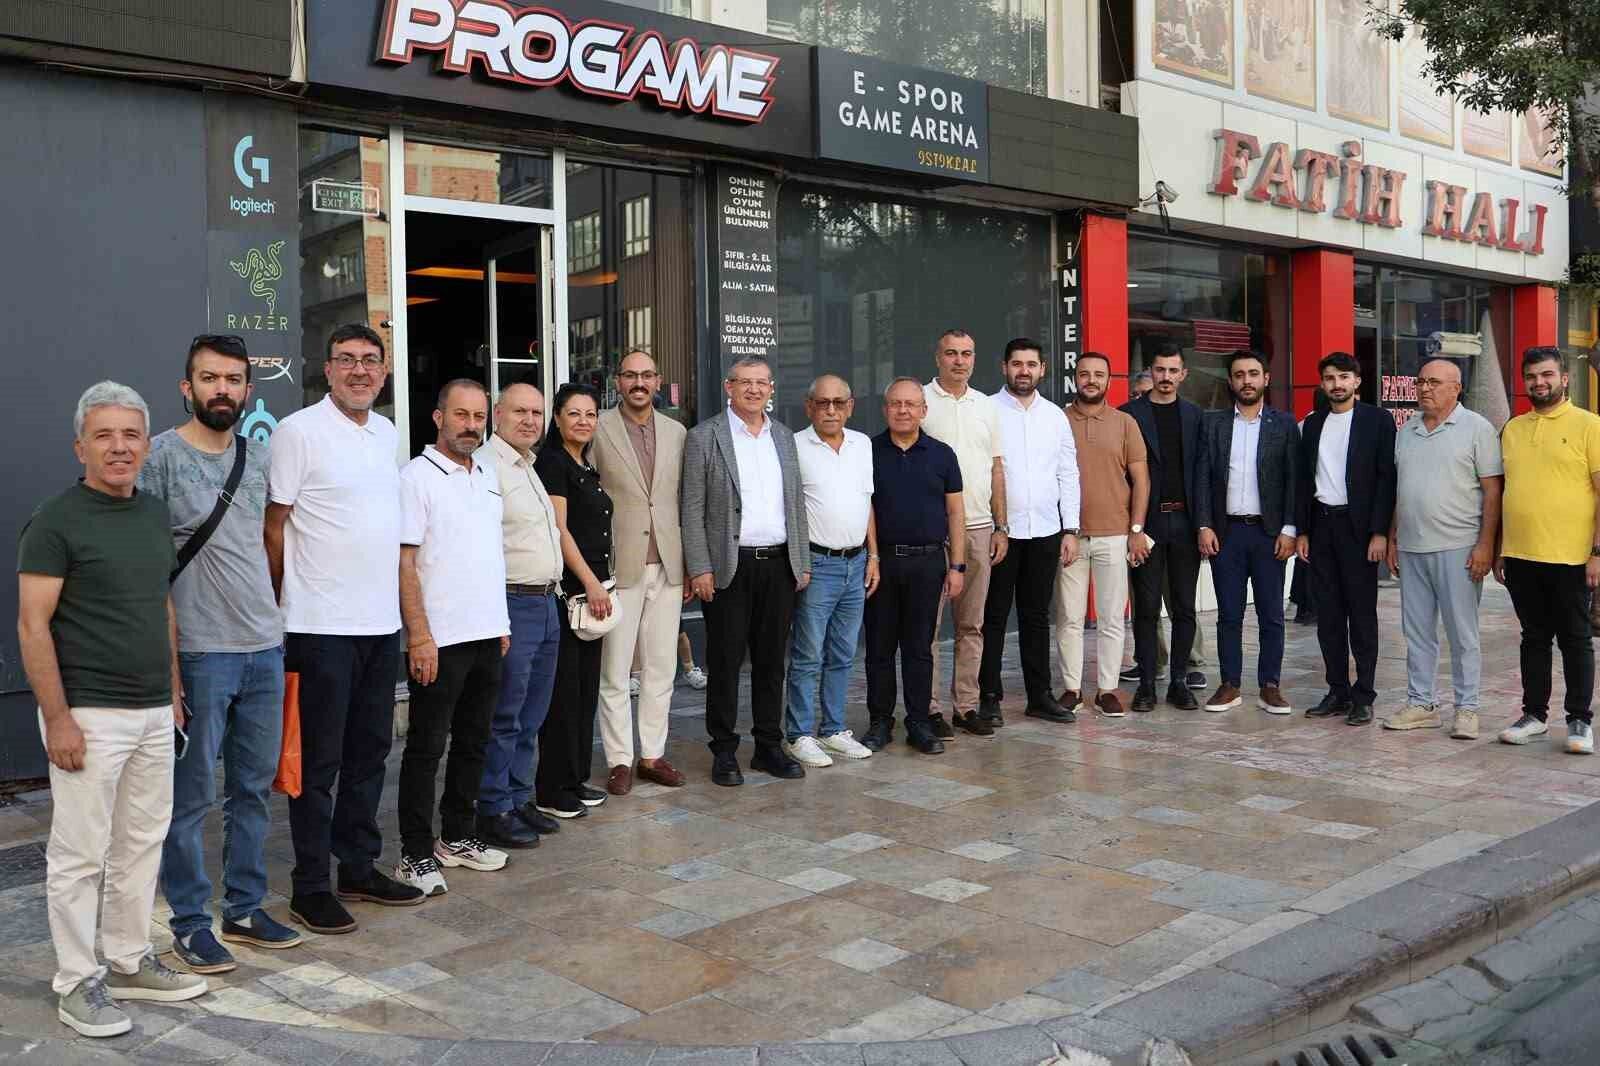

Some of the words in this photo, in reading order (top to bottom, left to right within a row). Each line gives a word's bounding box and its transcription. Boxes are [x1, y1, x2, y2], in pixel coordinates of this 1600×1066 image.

[381, 0, 779, 121] PROGAME
[853, 70, 866, 95] E
[898, 80, 965, 115] SPOR
[838, 101, 902, 135] GAME
[909, 115, 979, 150] ARENA
[230, 195, 275, 216] logitech
[321, 197, 344, 209] EXIT
[732, 197, 762, 208] OYUN
[725, 216, 769, 229] BULUNUR
[761, 253, 771, 263] EL
[722, 280, 743, 291] ALIM
[749, 282, 775, 293] SATIM
[227, 313, 288, 331] RAZER
[725, 324, 744, 335] OEM
[721, 334, 748, 345] YEDEK
[749, 336, 777, 348] PARÇA
[731, 345, 767, 356] BULUNUR
